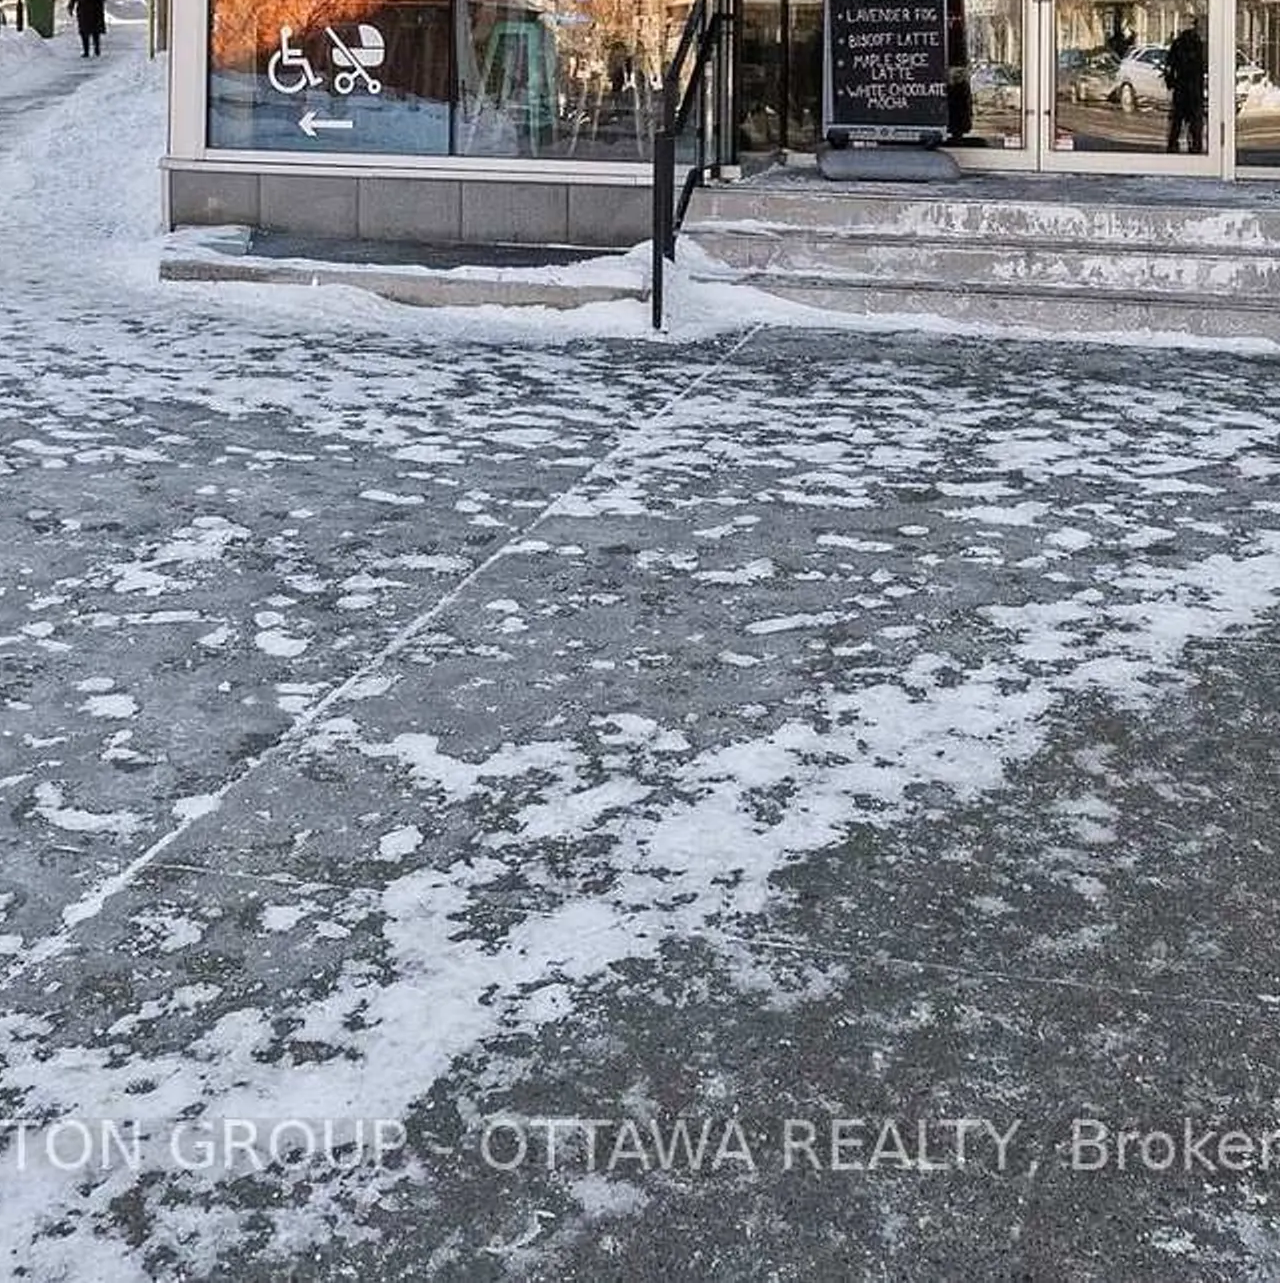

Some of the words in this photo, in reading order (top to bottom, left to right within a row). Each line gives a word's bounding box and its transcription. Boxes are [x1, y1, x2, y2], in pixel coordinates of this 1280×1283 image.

[845, 8, 911, 23] LAVENDER
[896, 32, 940, 47] LATTE
[852, 53, 894, 69] MAPLE
[894, 52, 929, 68] SPICE
[871, 67, 915, 81] LATTE
[845, 82, 886, 99] WHITE
[887, 81, 948, 97] CHOCOLATE
[866, 95, 910, 111] MOCHA
